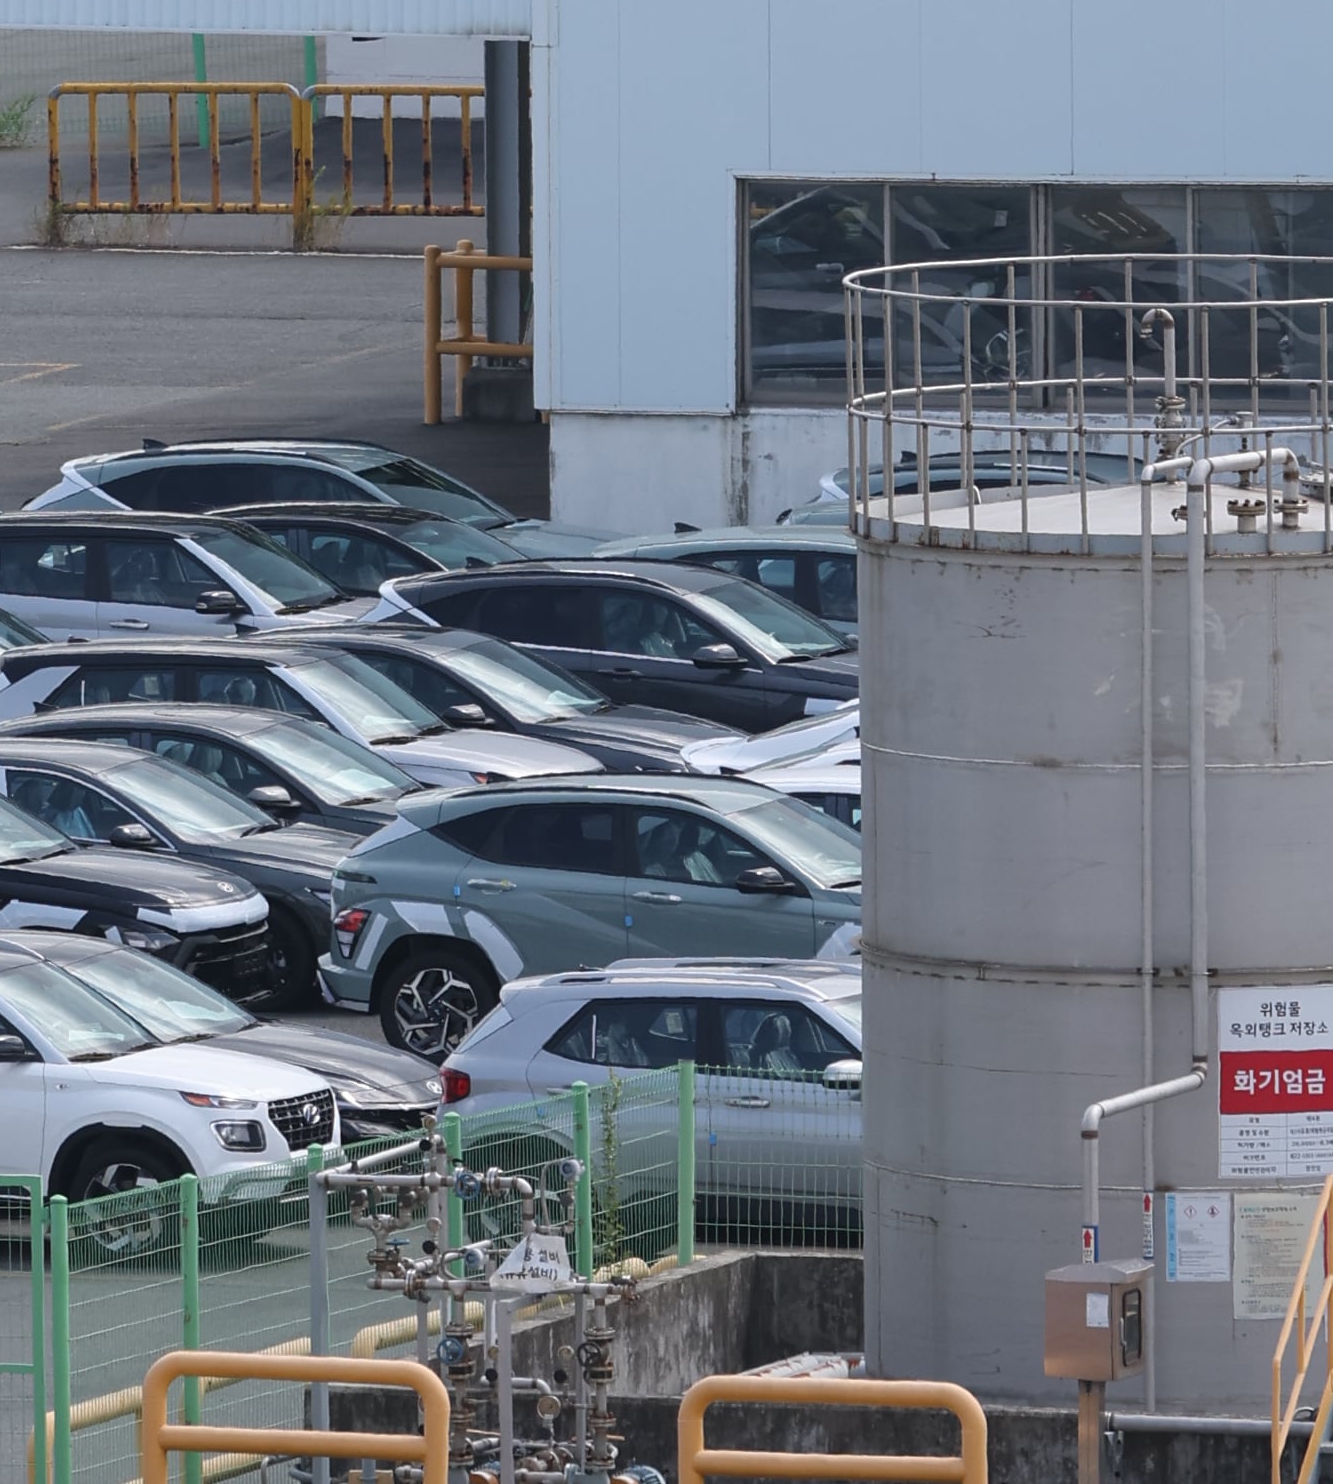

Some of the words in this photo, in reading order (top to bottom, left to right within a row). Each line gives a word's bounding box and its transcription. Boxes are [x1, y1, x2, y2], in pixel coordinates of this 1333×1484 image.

[1259, 1001, 1301, 1018] 위험물
[1229, 1022, 1286, 1038] 옥외탱크
[1289, 1020, 1329, 1037] 저장소
[1233, 1068, 1327, 1096] 화기엄금
